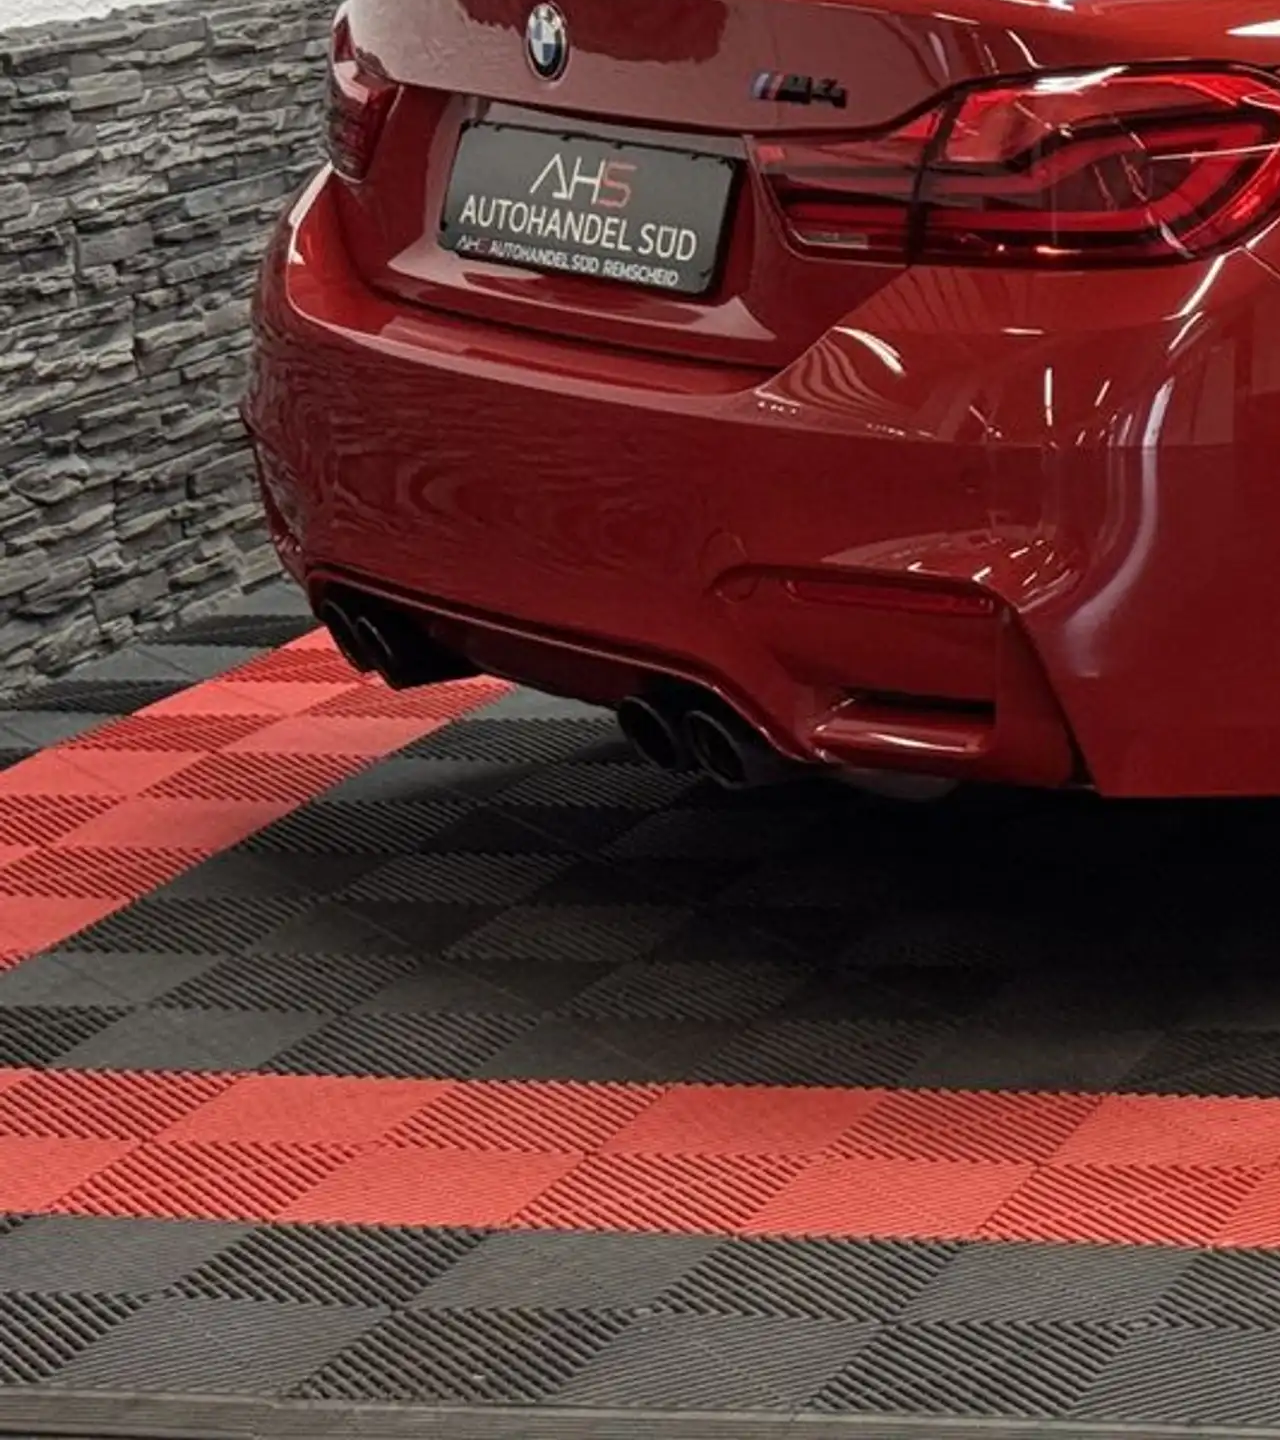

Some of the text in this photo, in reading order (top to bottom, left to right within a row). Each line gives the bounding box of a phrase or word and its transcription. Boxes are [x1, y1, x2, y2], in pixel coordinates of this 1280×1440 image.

[529, 153, 638, 209] AHS
[459, 195, 698, 261] AUTOHANDEL SÜD
[489, 239, 570, 267] AUTOHANDEL
[602, 258, 680, 287] REMSCHEID
